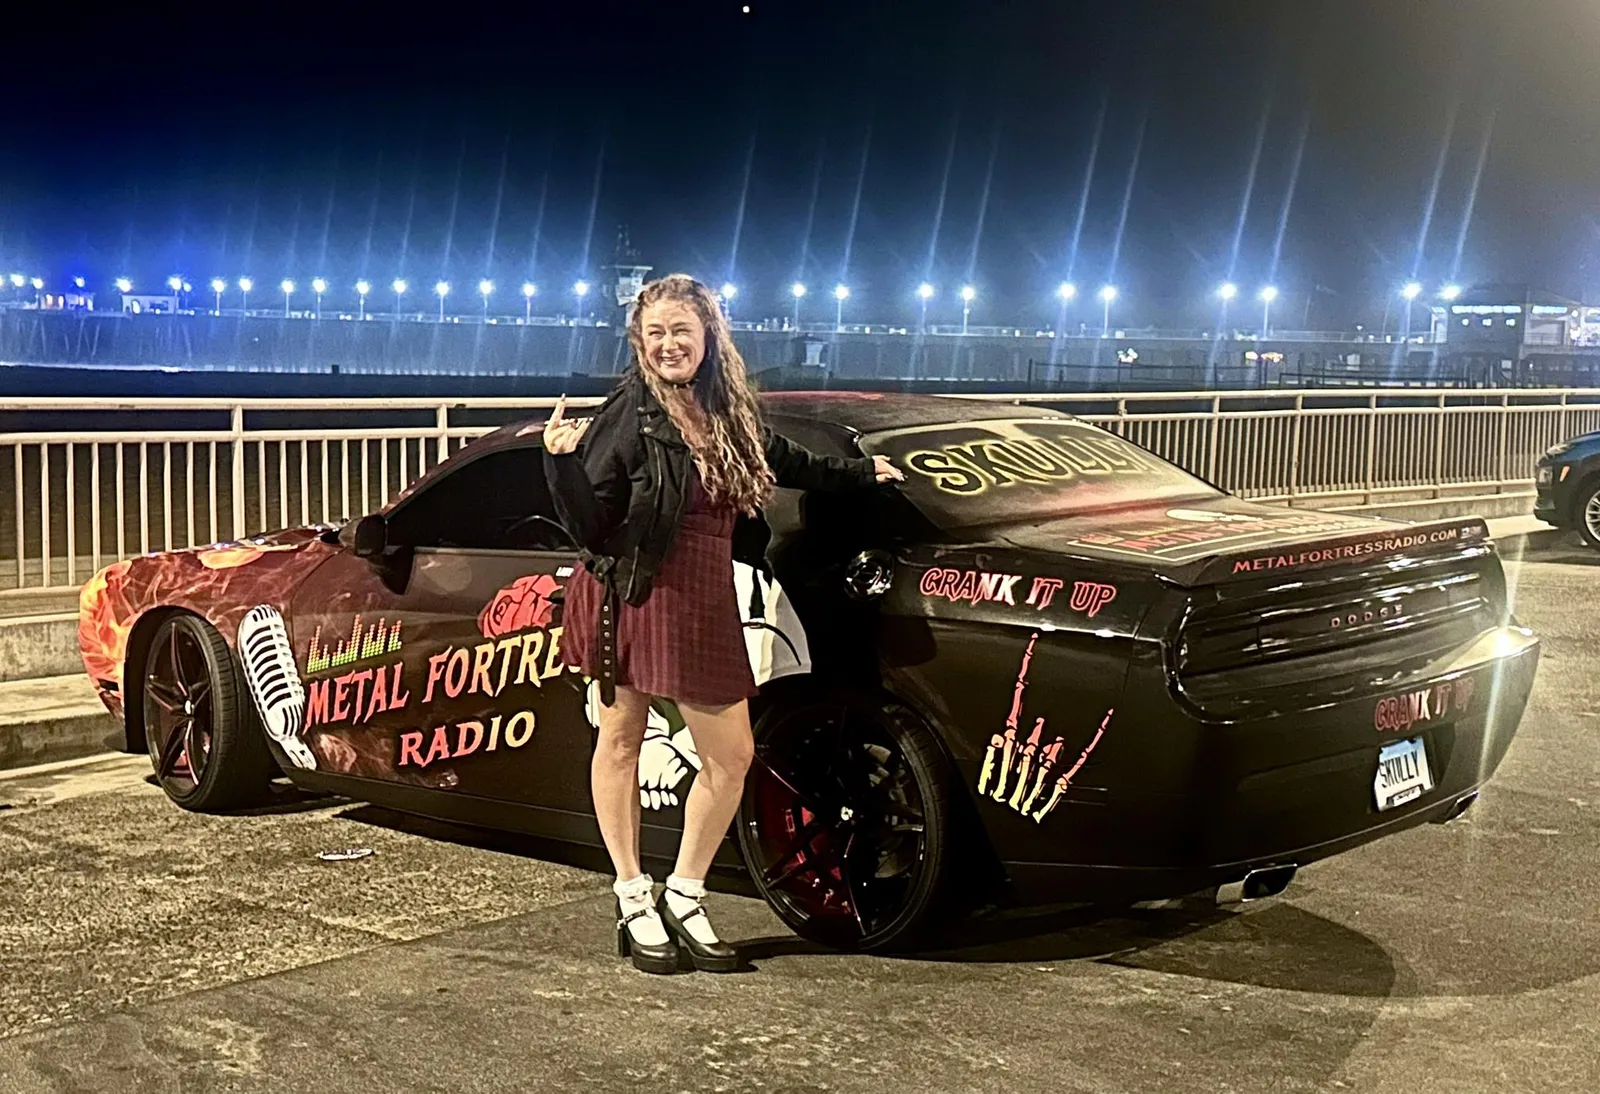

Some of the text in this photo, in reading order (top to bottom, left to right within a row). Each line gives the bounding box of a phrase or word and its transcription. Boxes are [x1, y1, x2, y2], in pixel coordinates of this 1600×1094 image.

[920, 568, 1117, 618] CRANK IT UP
[1331, 604, 1403, 628] DODGE
[302, 627, 582, 735] METAL FORTRE
[1375, 688, 1431, 731] CRANK
[1435, 683, 1452, 718] IT
[398, 710, 536, 768] RADIO
[1379, 750, 1420, 788] SKULLY
